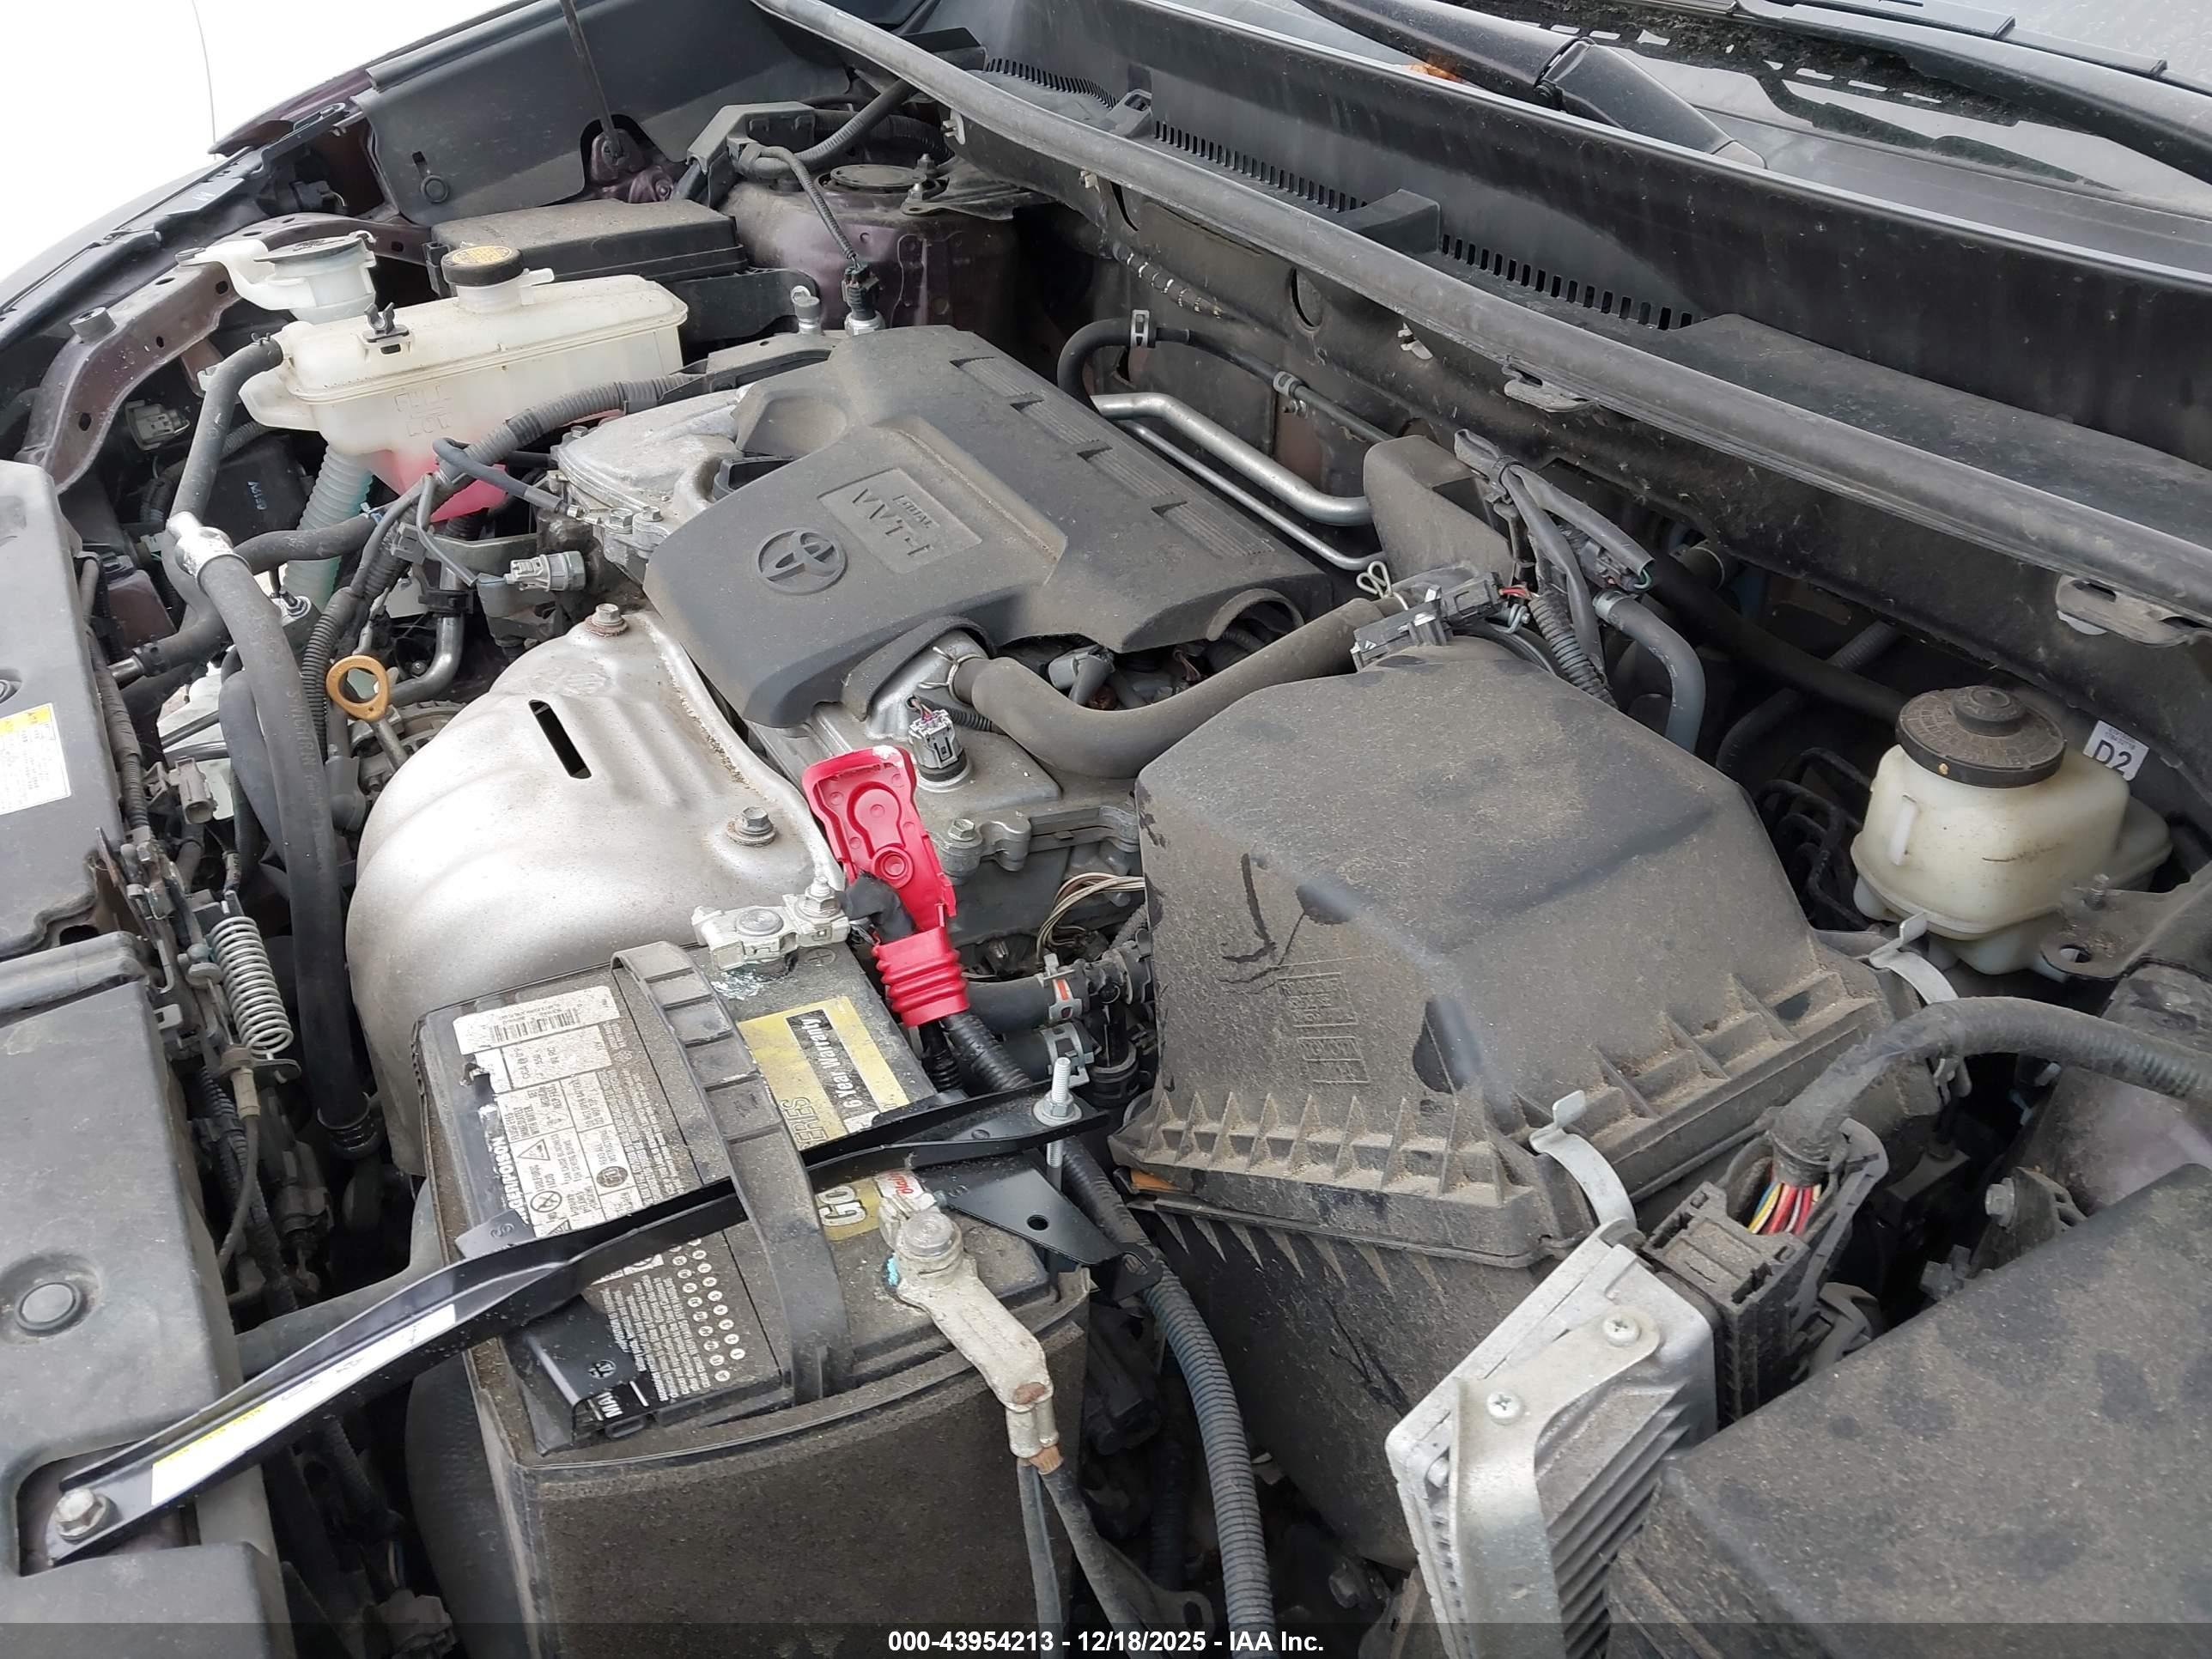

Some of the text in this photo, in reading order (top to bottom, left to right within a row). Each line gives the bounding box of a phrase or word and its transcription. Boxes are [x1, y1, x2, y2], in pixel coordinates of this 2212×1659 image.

[2093, 739, 2134, 775] D2
[801, 1018, 864, 1109] 6 Year Warranty
